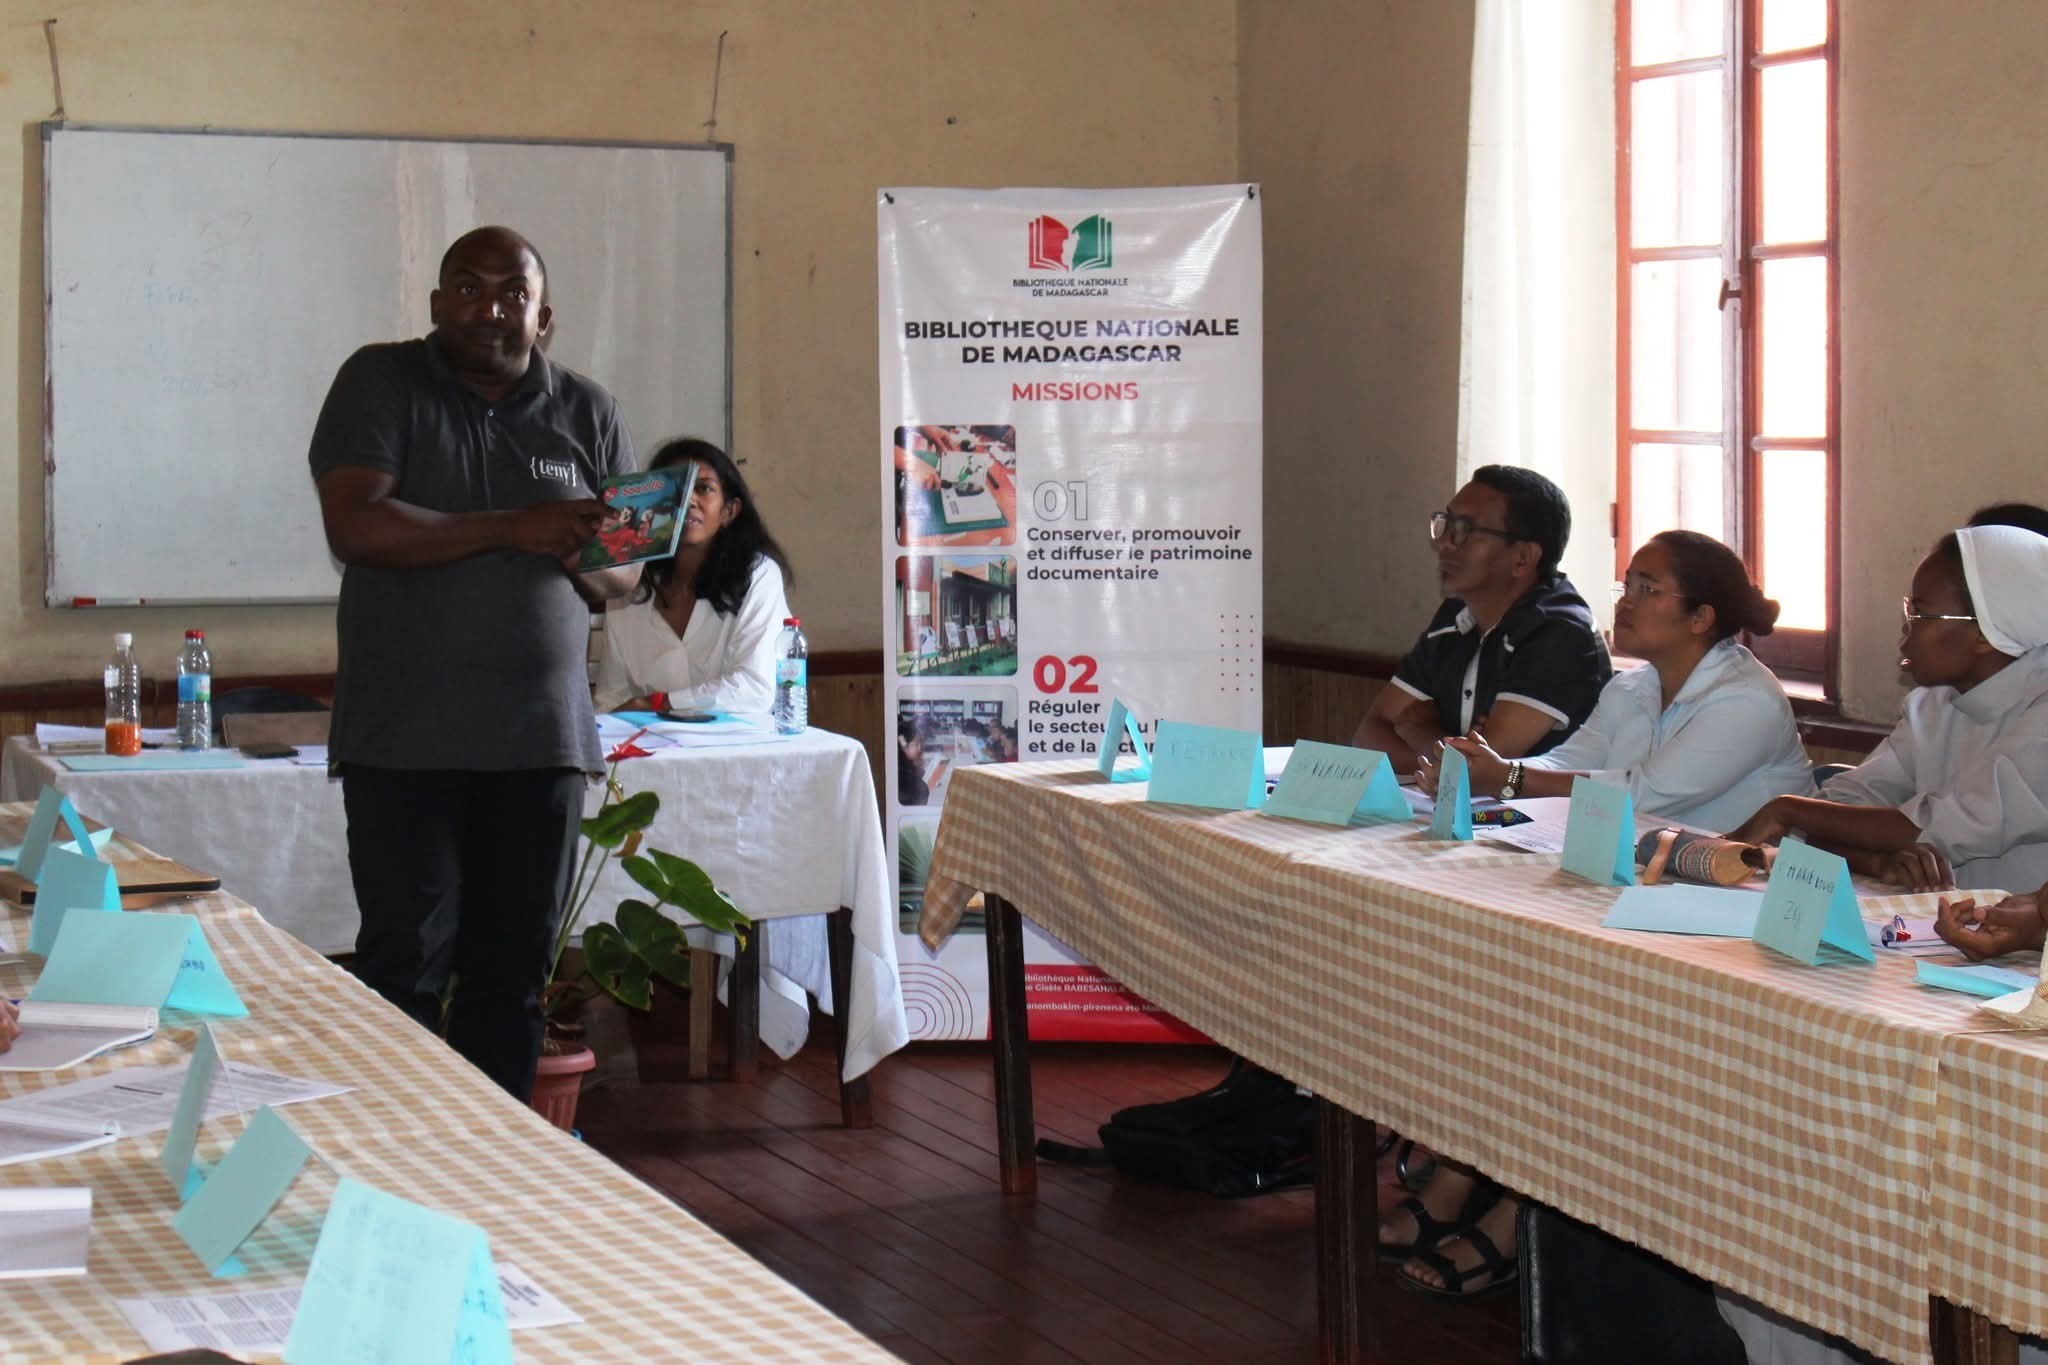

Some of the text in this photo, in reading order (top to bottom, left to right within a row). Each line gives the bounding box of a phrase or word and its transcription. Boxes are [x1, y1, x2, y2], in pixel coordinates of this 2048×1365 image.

[1013, 278, 1129, 287] BIBLIOTHEQUE NATIONALE
[1032, 288, 1109, 297] DE MADAGASCAR
[904, 319, 1240, 341] BIBLIOTHEQUE NATIONALE
[962, 344, 1182, 363] DE MADAGASCAR
[1012, 382, 1139, 401] MISSIONS
[1033, 480, 1088, 521] 01
[1027, 525, 1242, 544] Conserver, promouvoir
[1027, 545, 1253, 563] et diffuser le patrimoine
[1027, 565, 1159, 580] documentaire
[1033, 655, 1099, 694] 02
[1028, 699, 1101, 717] Réguler
[1029, 719, 1045, 733] le
[1050, 720, 1106, 733] secte
[1028, 738, 1096, 753] et de la
[1025, 973, 1075, 985] ibliothèque
